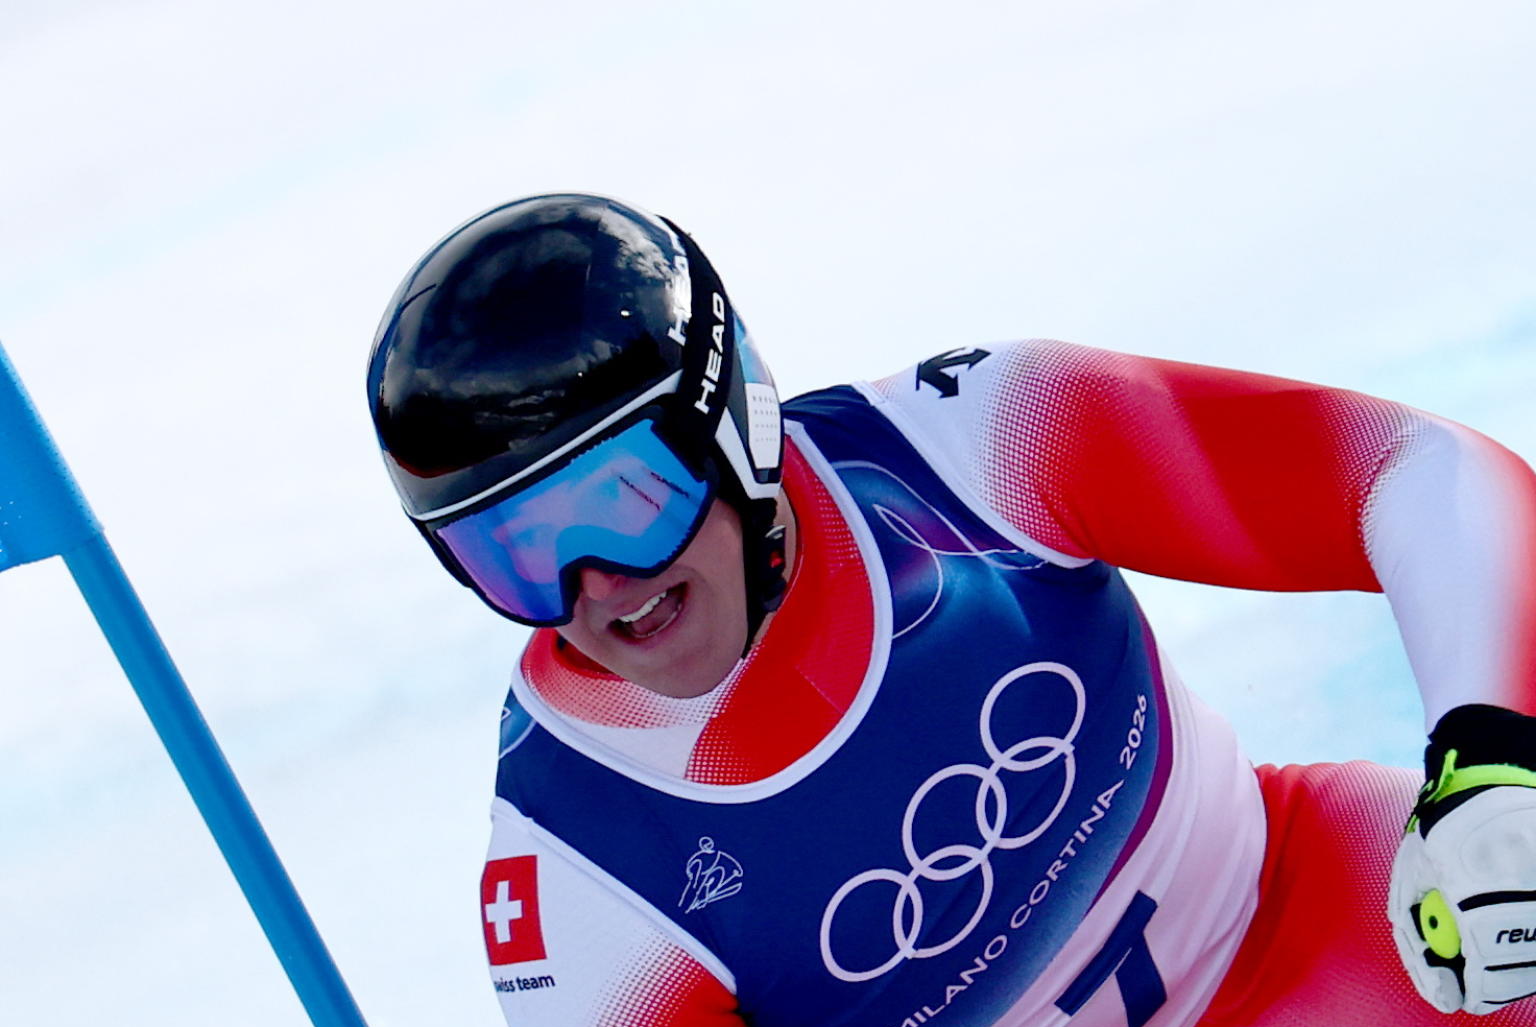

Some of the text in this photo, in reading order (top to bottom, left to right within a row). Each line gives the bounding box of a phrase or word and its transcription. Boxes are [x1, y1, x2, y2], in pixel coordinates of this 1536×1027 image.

[694, 291, 725, 415] HEAD
[1010, 778, 1124, 929] CORTINA
[1119, 693, 1147, 770] 2026
[494, 974, 556, 993] wiss team
